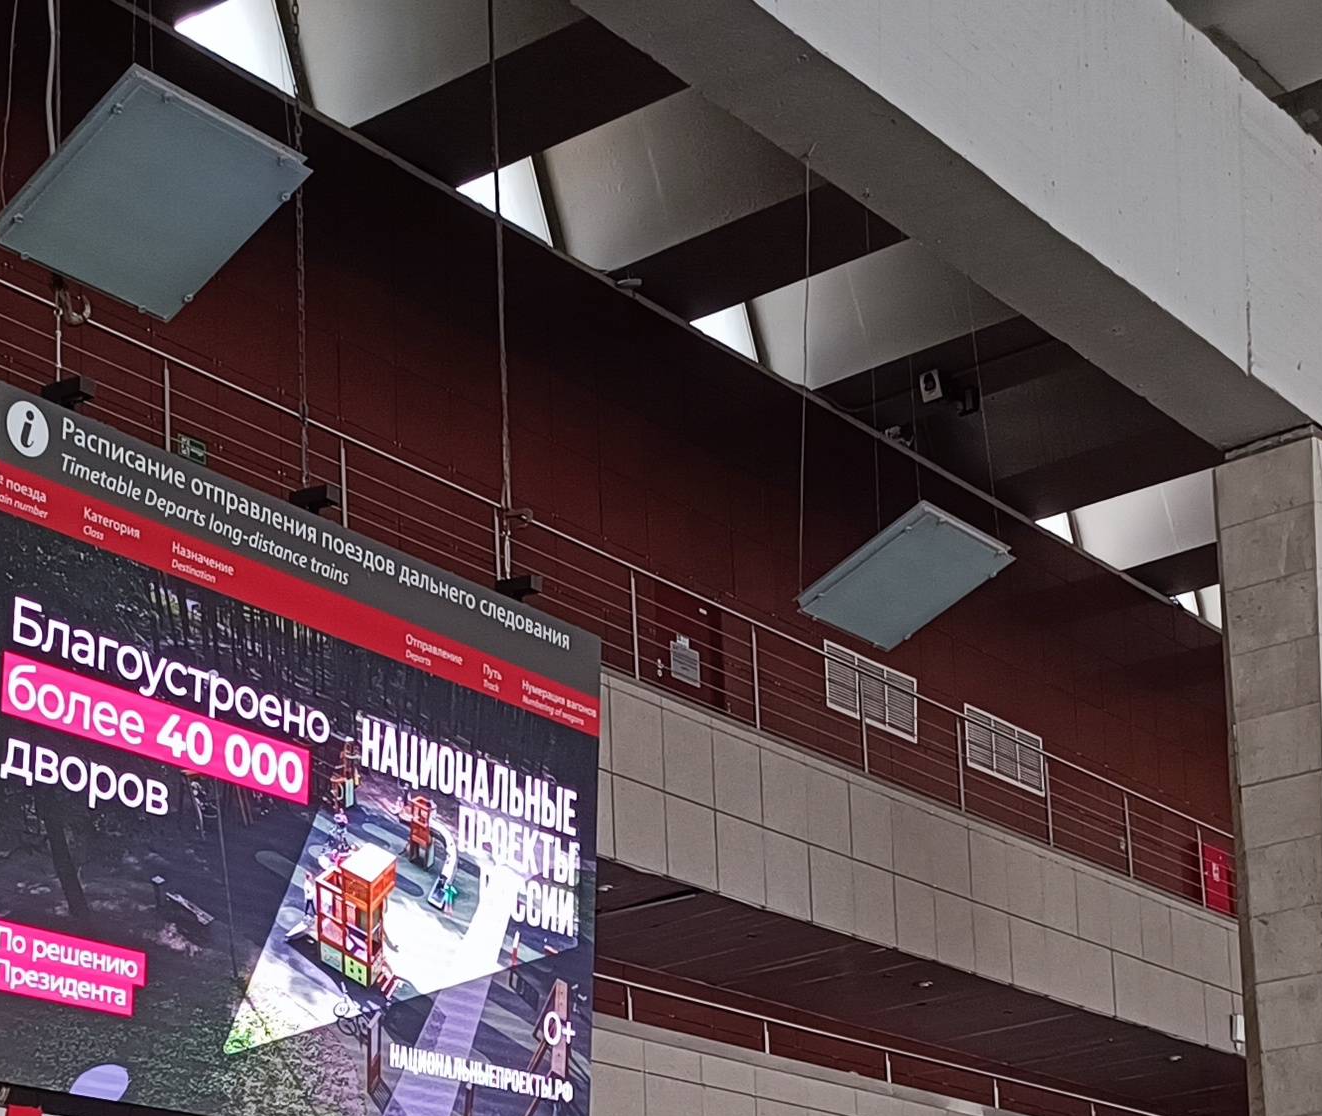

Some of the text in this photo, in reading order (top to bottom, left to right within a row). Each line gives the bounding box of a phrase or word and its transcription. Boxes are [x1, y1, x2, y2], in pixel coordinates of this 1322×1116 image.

[5, 475, 47, 504] поезда
[14, 498, 48, 519] number
[61, 452, 349, 586] Timetable Departs long-distance trains
[62, 417, 570, 650] Расписание отправления поездов дальнего следования
[83, 506, 140, 540] Категория
[172, 541, 235, 577] Назначение
[172, 559, 216, 584] Destination
[405, 633, 464, 666] Отправление
[12, 595, 331, 745] Благоустроено
[482, 663, 503, 682] Путь
[522, 679, 597, 719] Нумерация вагонов
[7, 663, 304, 795] более 40 000
[0, 737, 169, 817] дворов
[361, 716, 578, 837] НАЦИОНАЛЬНЫЕ
[457, 805, 580, 888] ПРОЕКТЫ
[480, 866, 575, 938] РССИИ
[32, 939, 138, 979] решению
[543, 1011, 576, 1046] 0+
[389, 1042, 574, 1103] НАЦИОНАЛЬНЫЕПРОЕКТЫ.РФ
